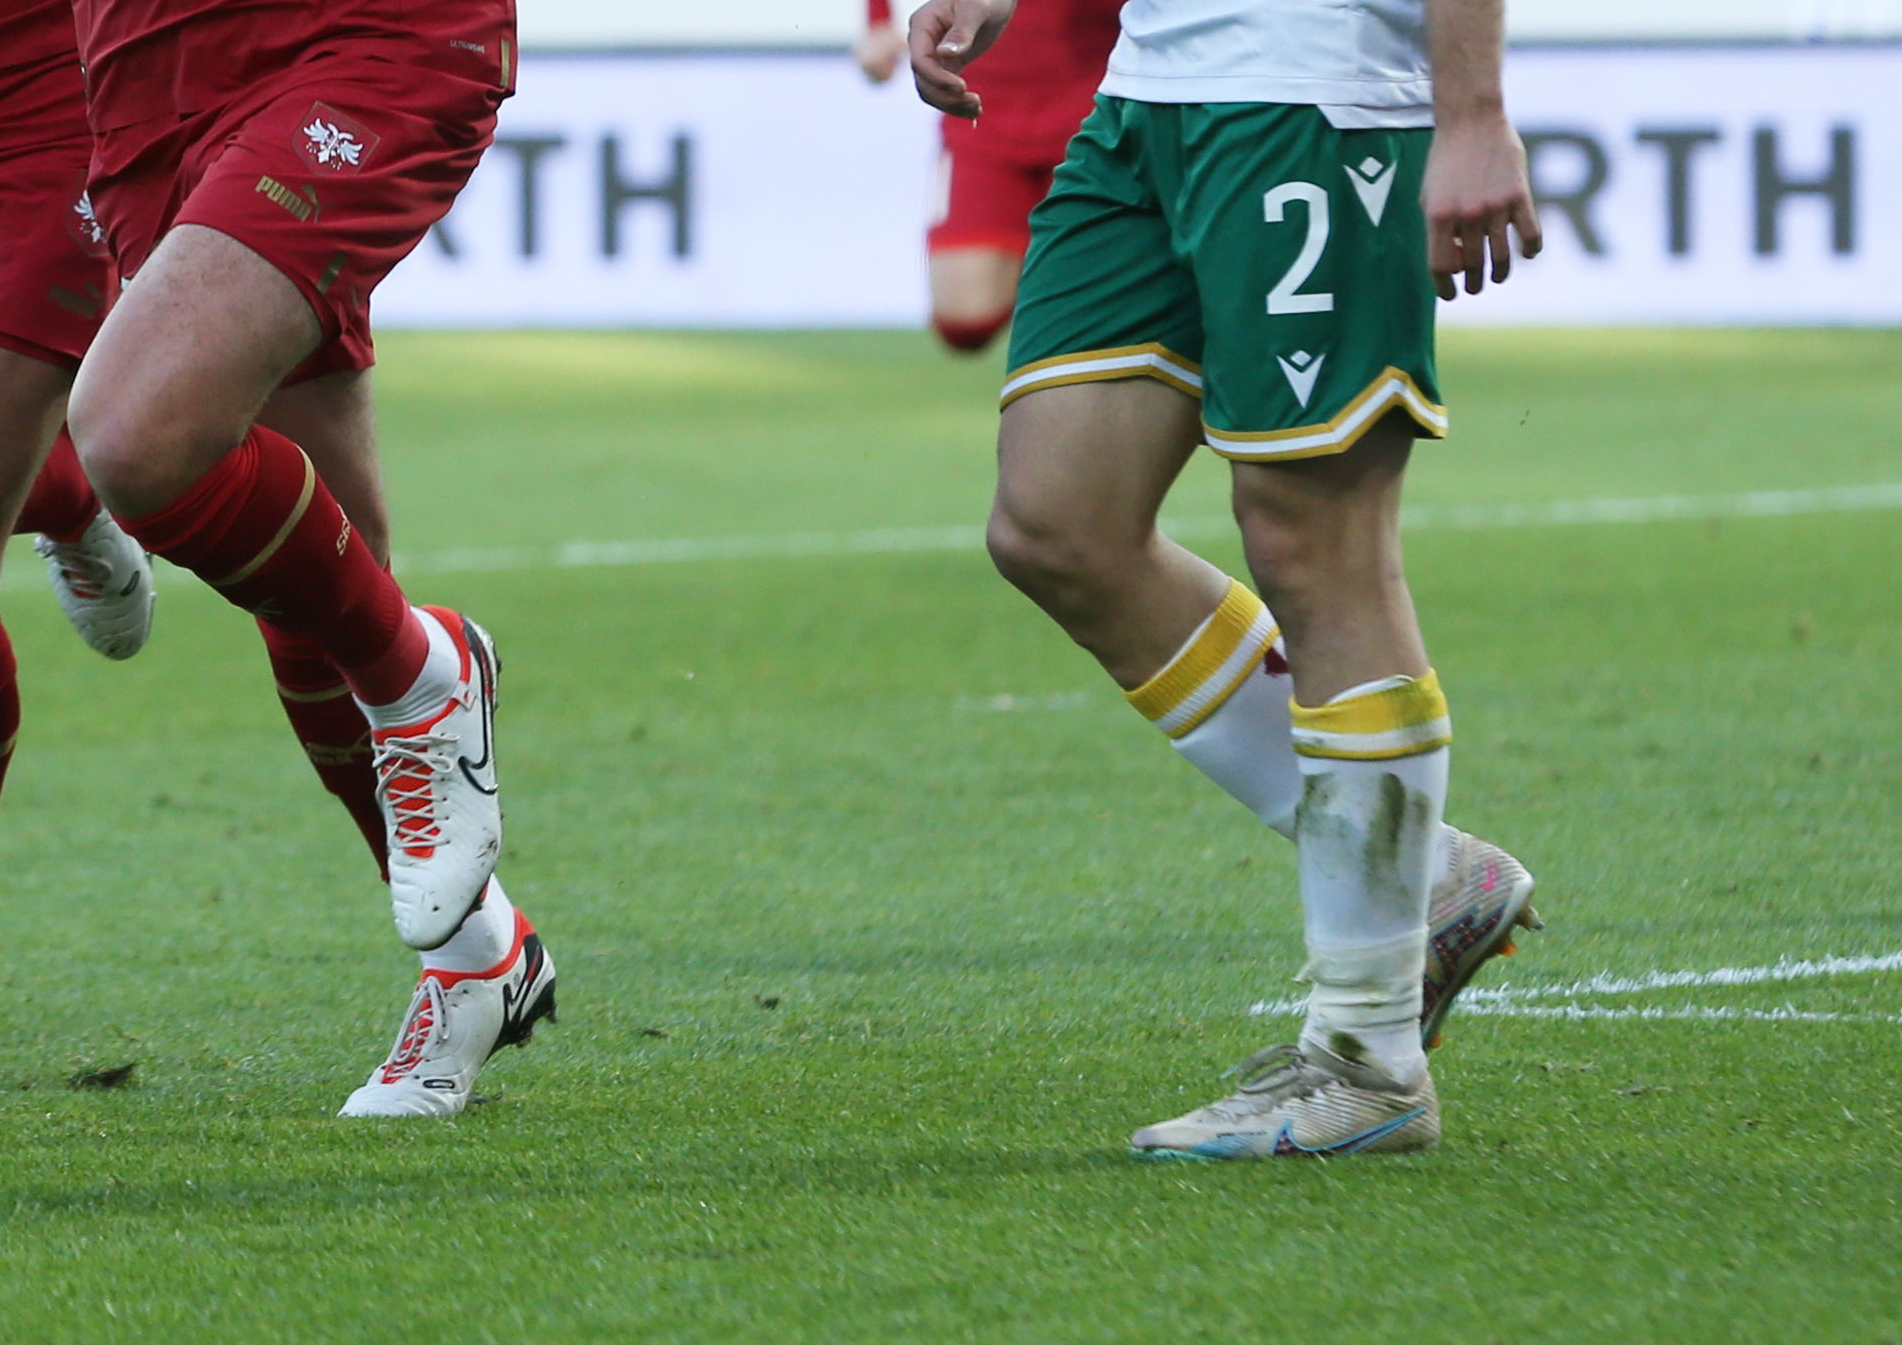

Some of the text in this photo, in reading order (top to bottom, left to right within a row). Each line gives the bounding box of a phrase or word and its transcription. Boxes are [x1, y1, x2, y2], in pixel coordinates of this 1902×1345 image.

[254, 174, 313, 222] PUMA
[1263, 180, 1334, 315] 2
[1520, 126, 1856, 259] RTH
